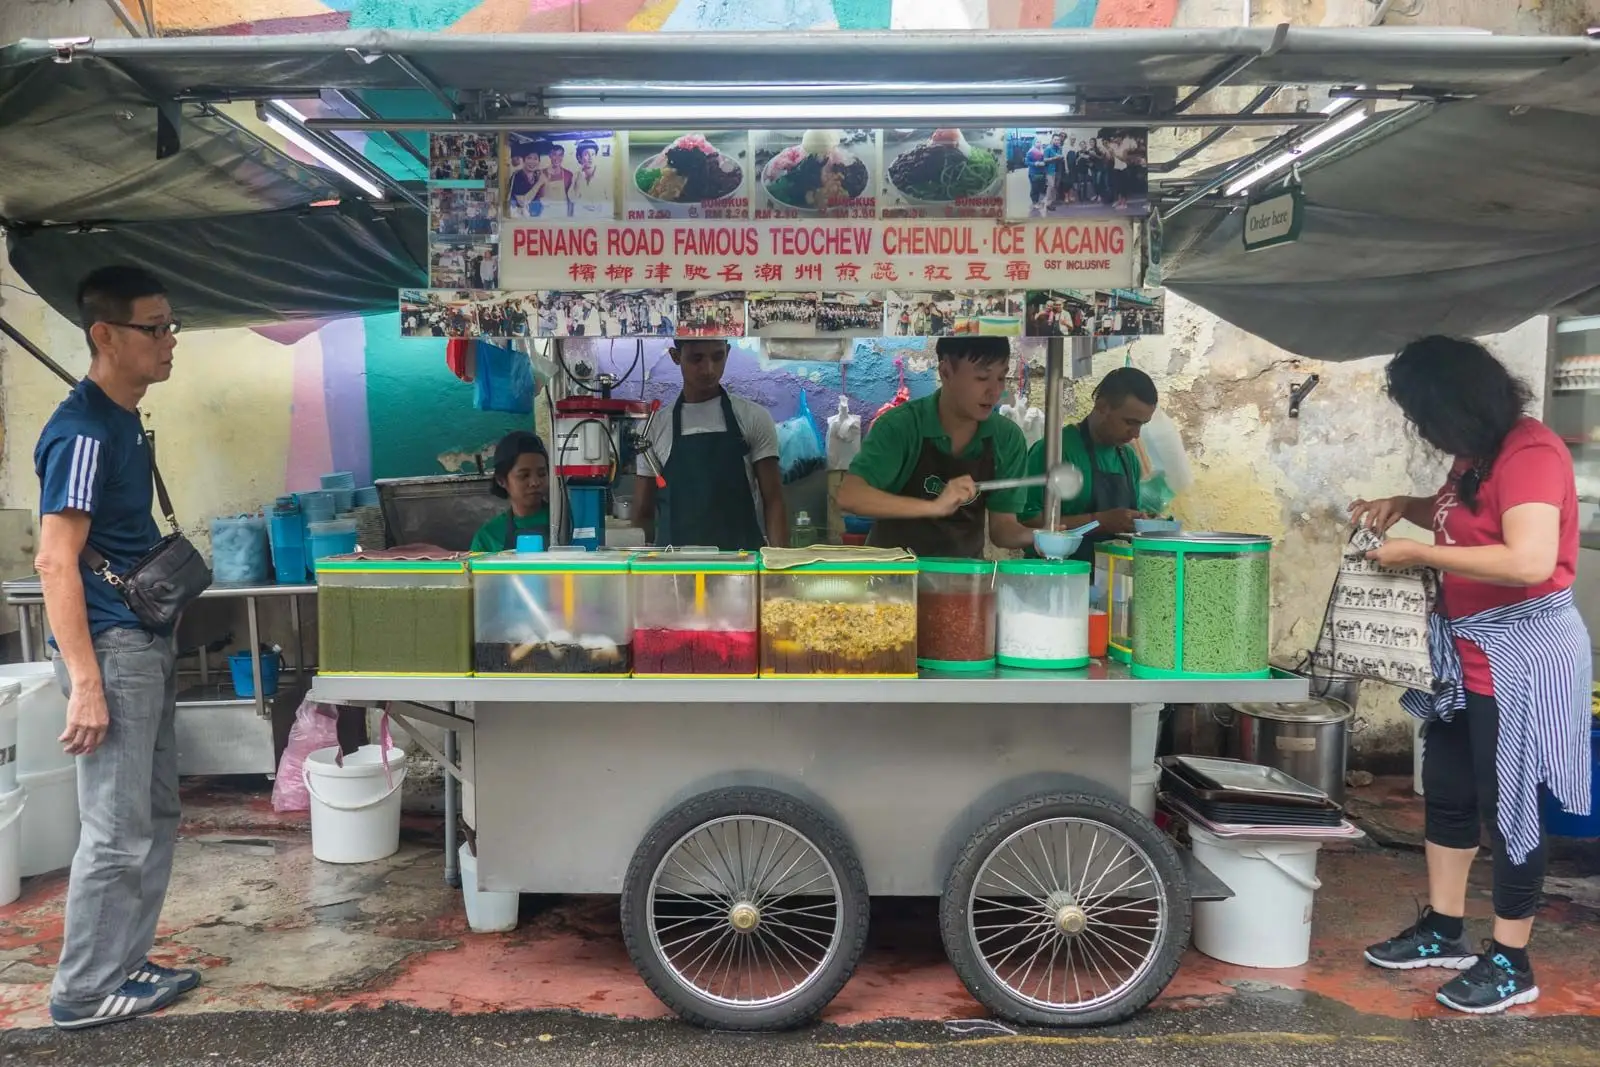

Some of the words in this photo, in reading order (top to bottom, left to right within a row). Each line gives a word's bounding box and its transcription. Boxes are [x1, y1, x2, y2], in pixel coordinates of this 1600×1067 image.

[628, 210, 645, 219] RM
[1250, 213, 1271, 231] Order
[1272, 210, 1288, 225] here
[513, 228, 598, 256] PENANG
[607, 227, 664, 256] ROAD
[674, 227, 759, 256] FAMOUS
[769, 226, 872, 256] TEOCHEW
[1035, 226, 1125, 254] KACANG
[1044, 260, 1061, 269] GST
[1066, 260, 1110, 270] INCLUSIVE
